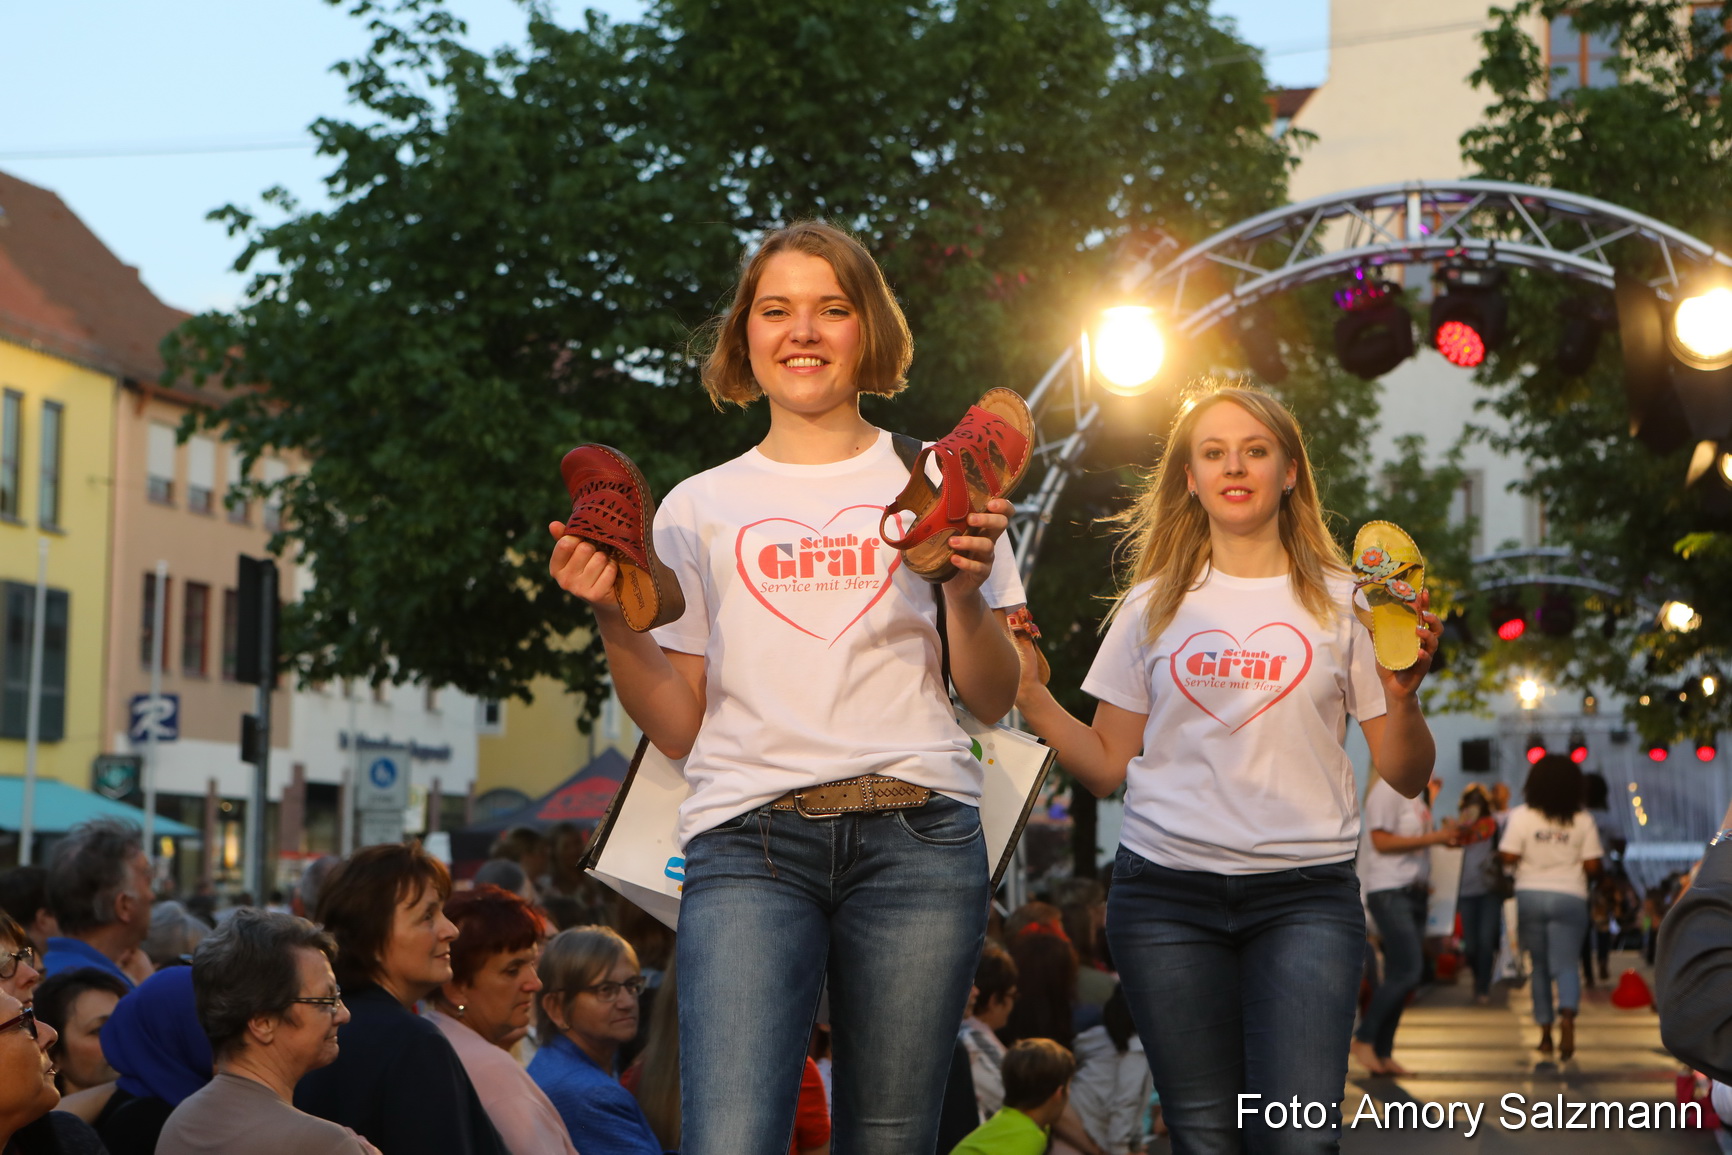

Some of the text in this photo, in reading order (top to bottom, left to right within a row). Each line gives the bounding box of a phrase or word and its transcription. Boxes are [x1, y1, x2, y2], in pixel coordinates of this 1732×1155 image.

[800, 533, 858, 550] Schuh
[758, 537, 880, 579] Graf
[760, 577, 880, 593] Service mit Herz
[1222, 649, 1270, 659] Schuh
[1186, 652, 1288, 681] Graf
[1184, 677, 1282, 693] Service mit Herz
